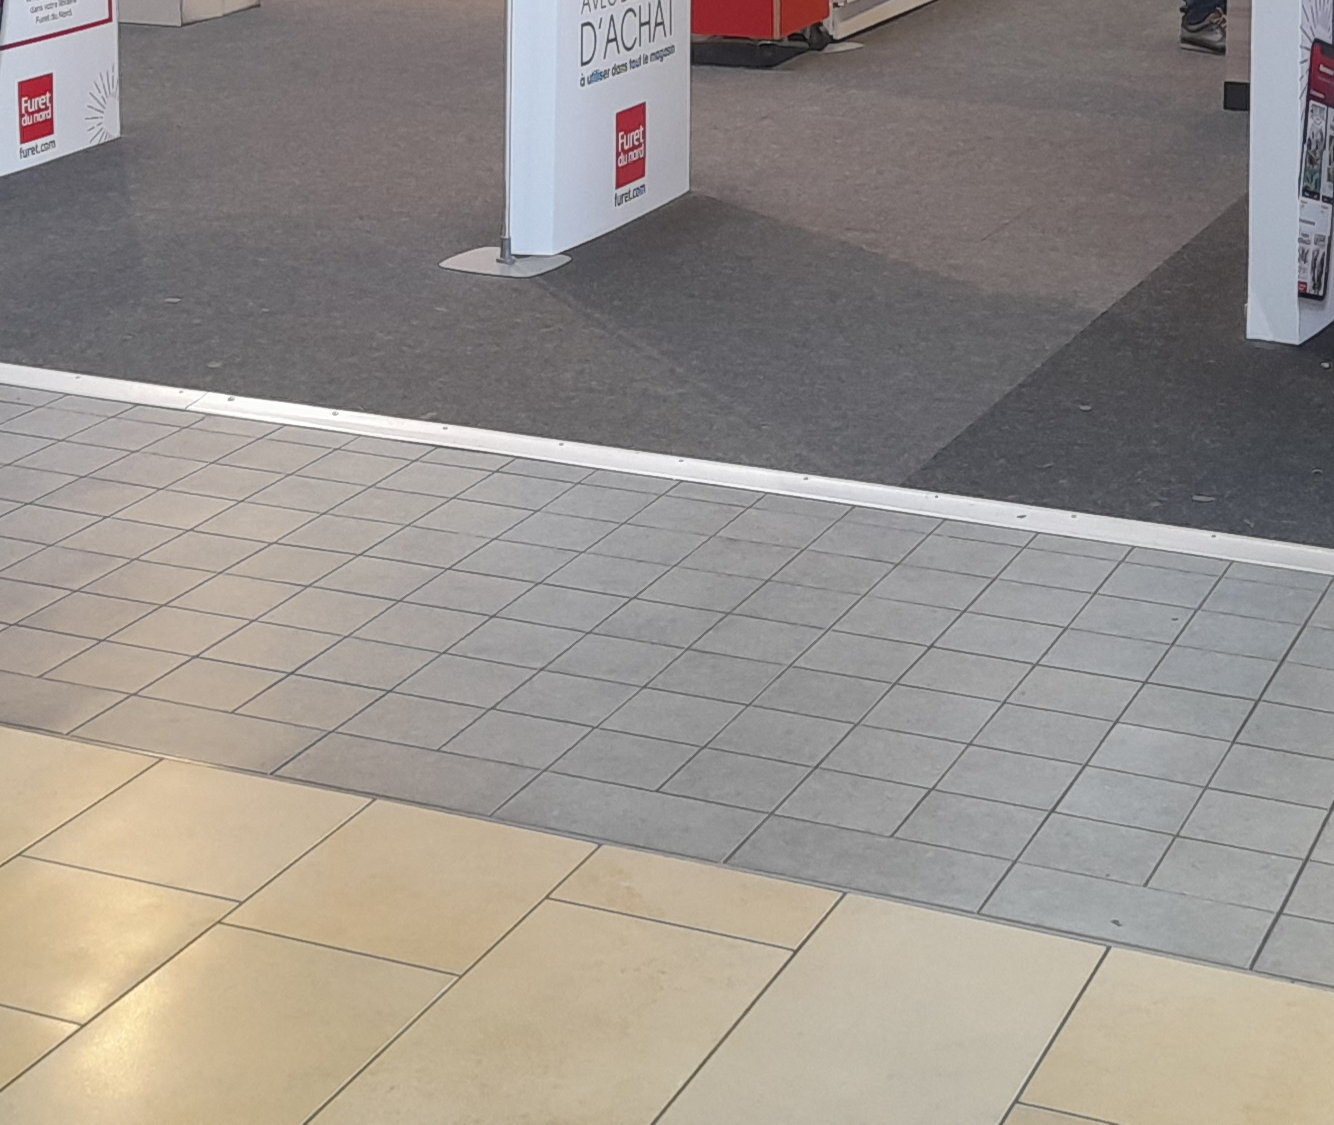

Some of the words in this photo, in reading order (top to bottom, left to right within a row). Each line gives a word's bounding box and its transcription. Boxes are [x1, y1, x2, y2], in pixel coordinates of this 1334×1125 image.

[21, 91, 51, 114] Furet
[22, 113, 33, 126] du
[33, 109, 52, 123] nord
[19, 139, 56, 160] furet.com
[618, 125, 644, 152] Furet
